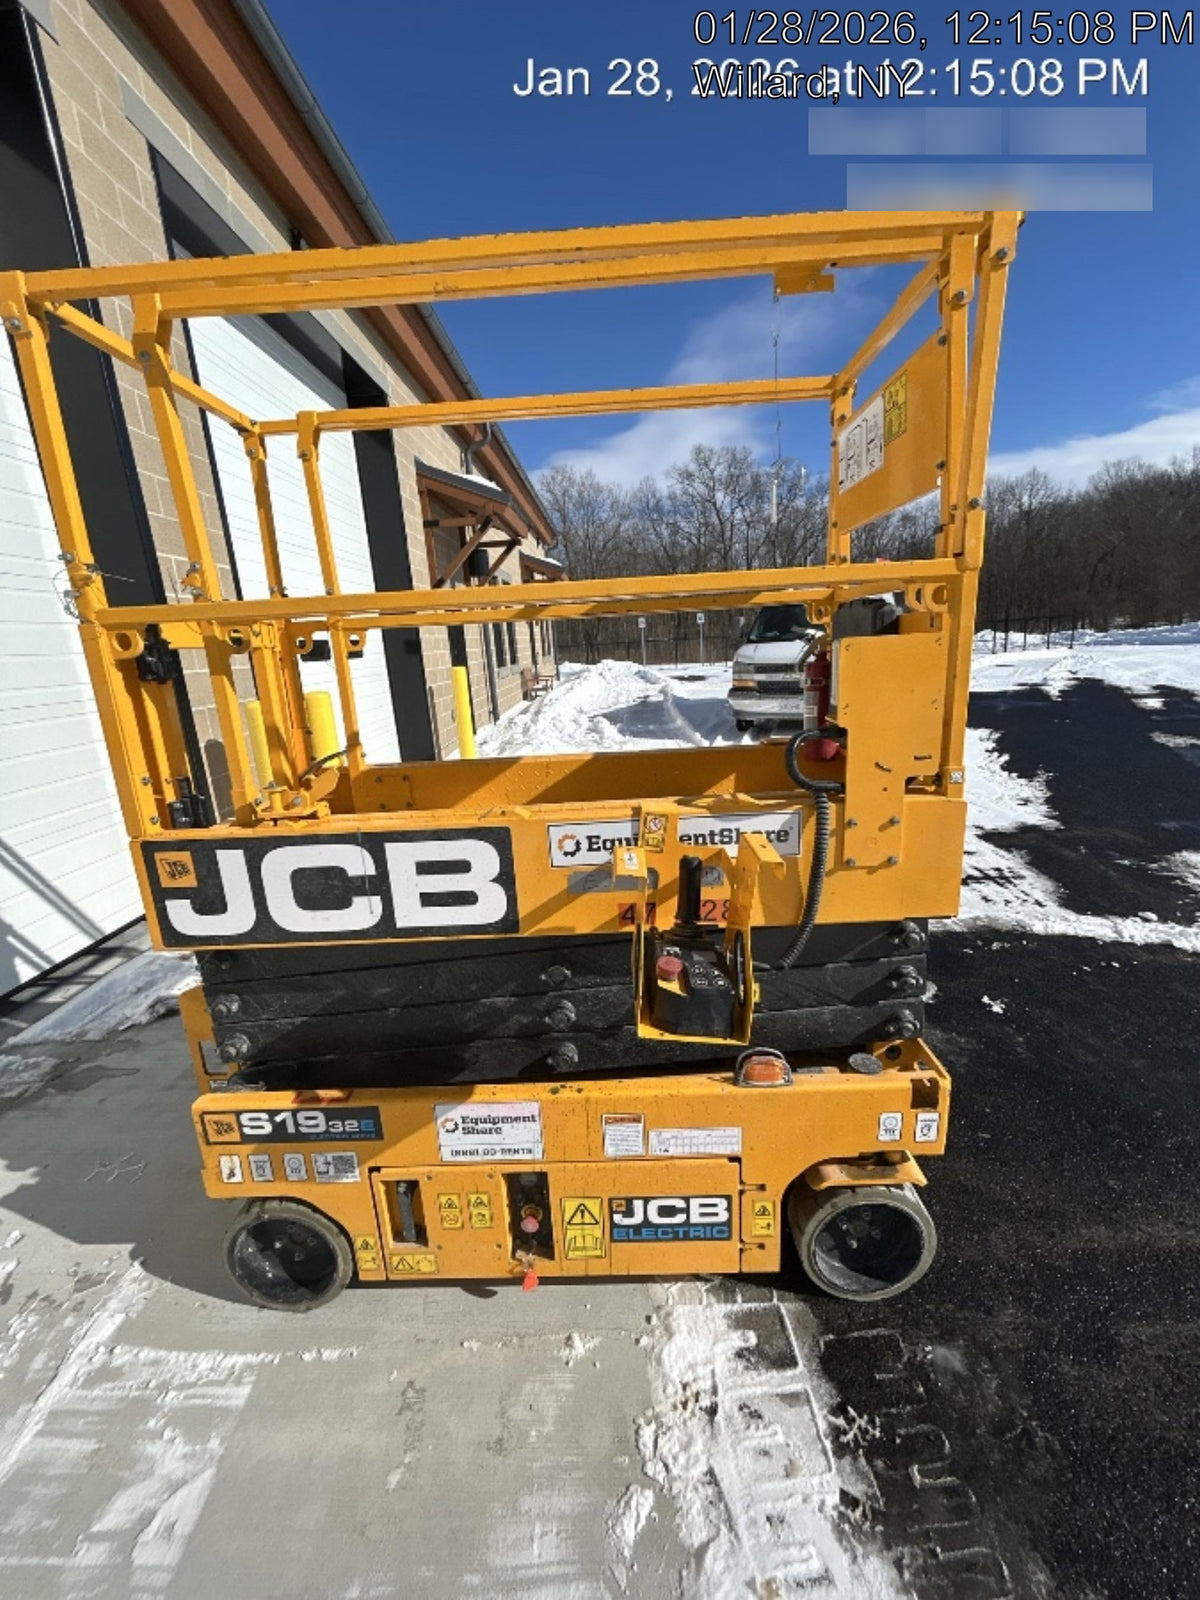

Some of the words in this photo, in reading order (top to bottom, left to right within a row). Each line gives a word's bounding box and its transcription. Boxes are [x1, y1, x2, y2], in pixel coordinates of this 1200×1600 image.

[165, 838, 507, 936] JCB
[460, 1114, 538, 1126] Equipment
[462, 1125, 503, 1135] Share
[612, 1198, 730, 1226] JCB
[612, 1226, 730, 1241] ELECTRIC
